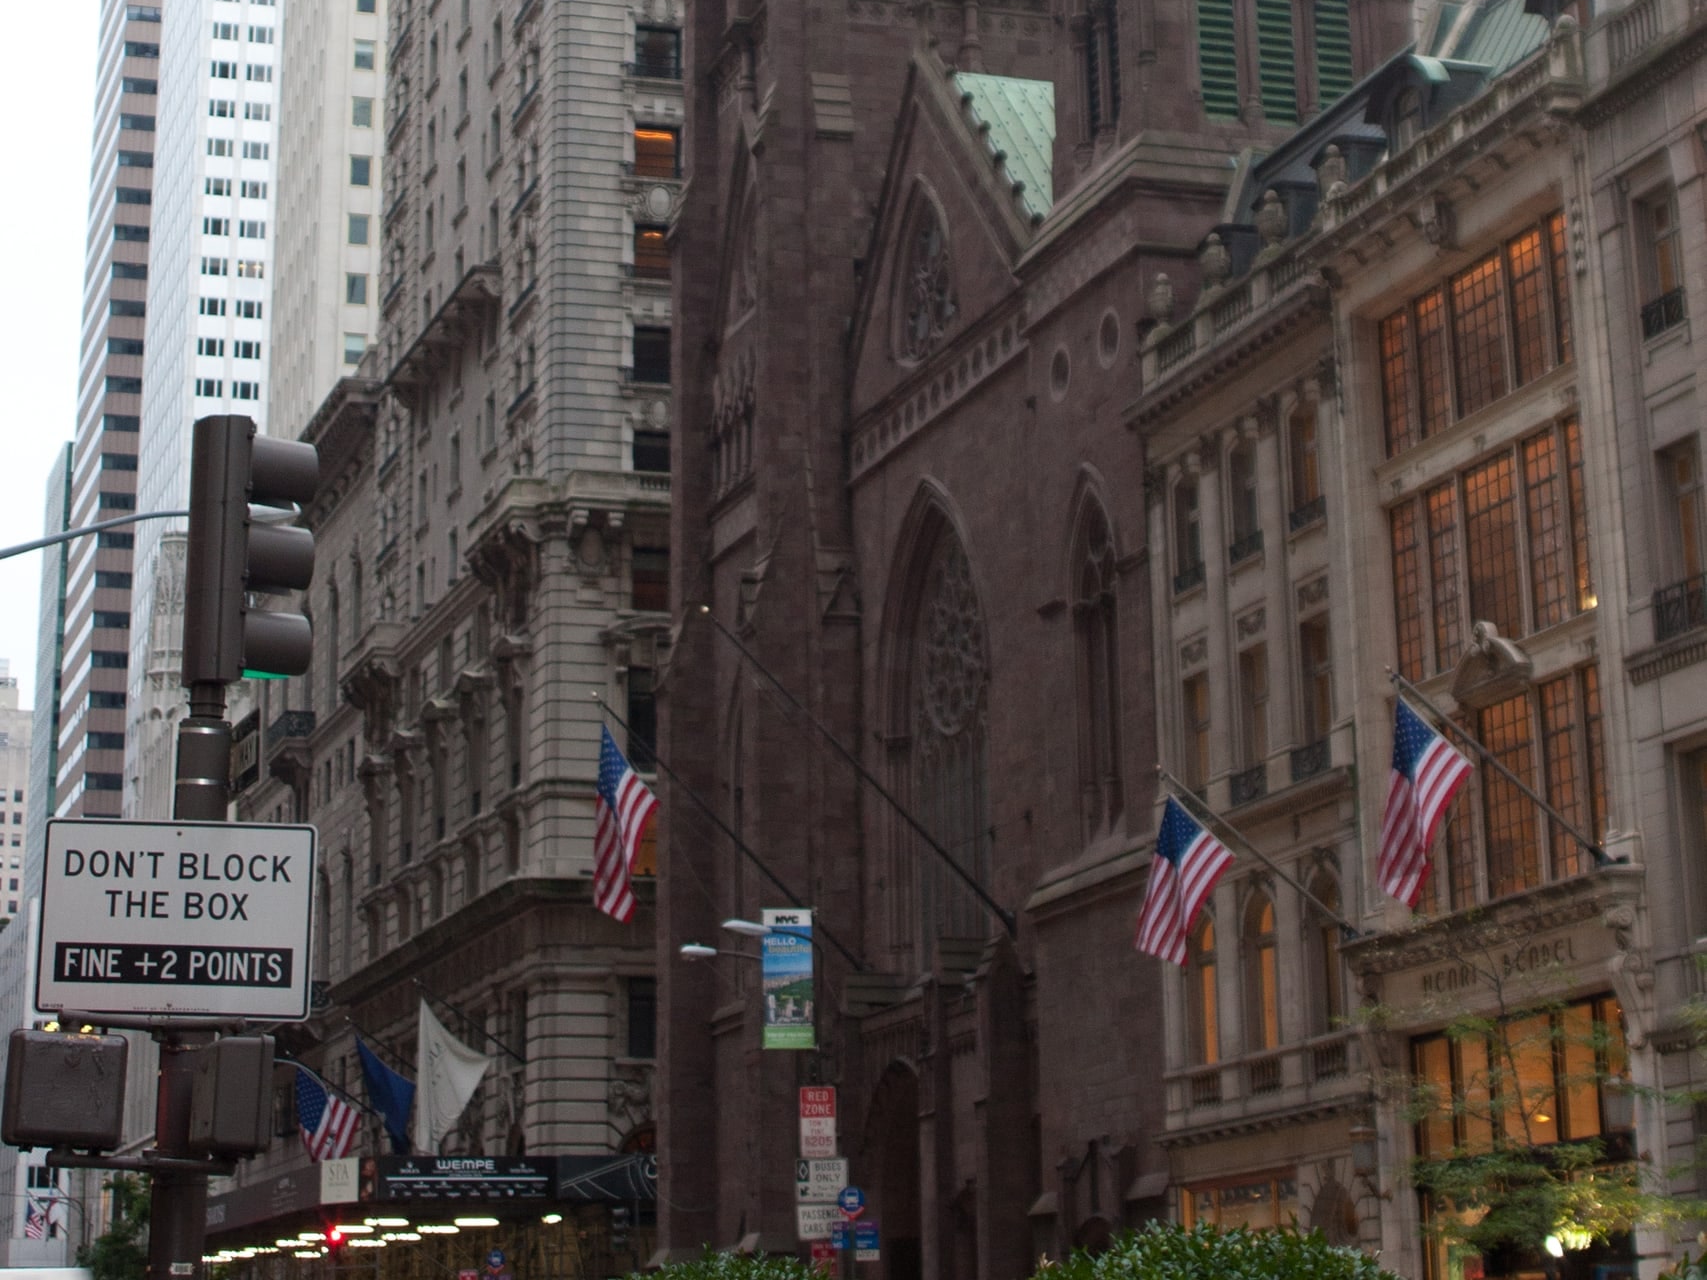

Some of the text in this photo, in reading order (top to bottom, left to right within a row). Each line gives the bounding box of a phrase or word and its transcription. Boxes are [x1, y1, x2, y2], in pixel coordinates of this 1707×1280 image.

[64, 849, 292, 883] DON'T BLOCK
[105, 889, 249, 921] THE BOX
[775, 915, 800, 924] NYC
[763, 937, 797, 946] HELLO
[63, 947, 283, 983] FINE +2 POINTS
[808, 1091, 829, 1102] RED
[804, 1103, 832, 1115] ZONE
[436, 1159, 495, 1170] WEMPE
[815, 1162, 842, 1171] BUSES
[815, 1174, 841, 1182] ONLY
[801, 1209, 843, 1220] PASSENGE
[804, 1222, 824, 1233] CARS
